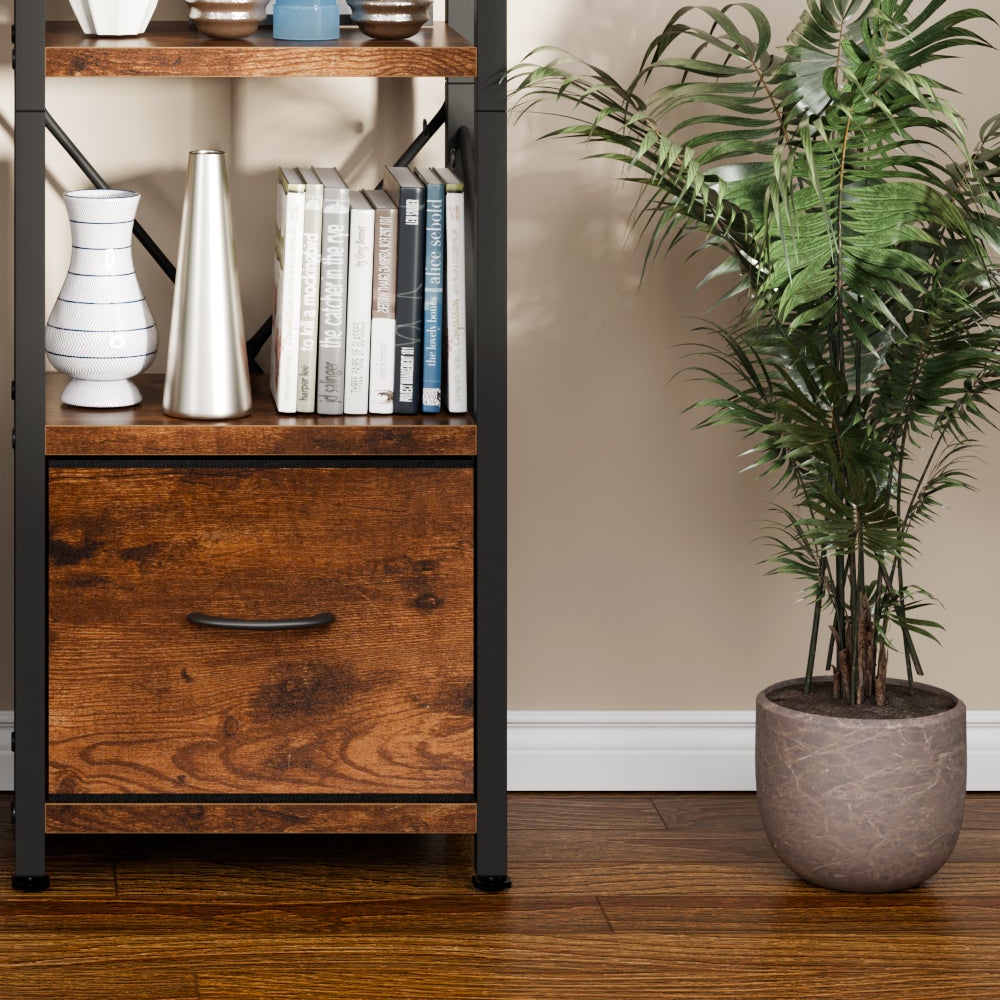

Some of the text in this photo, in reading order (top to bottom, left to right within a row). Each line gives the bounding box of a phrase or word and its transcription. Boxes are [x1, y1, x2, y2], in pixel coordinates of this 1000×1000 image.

[303, 232, 321, 306] mockingbird
[425, 199, 443, 285] alice sebold
[320, 224, 349, 349] the catcher in the rye
[301, 320, 316, 337] kill
[301, 339, 314, 352] to
[351, 321, 365, 394] THREE PAIRS OF GLASSES
[425, 296, 439, 367] the lovely bones
[300, 365, 309, 401] harper lee
[320, 361, 342, 393] salinger
